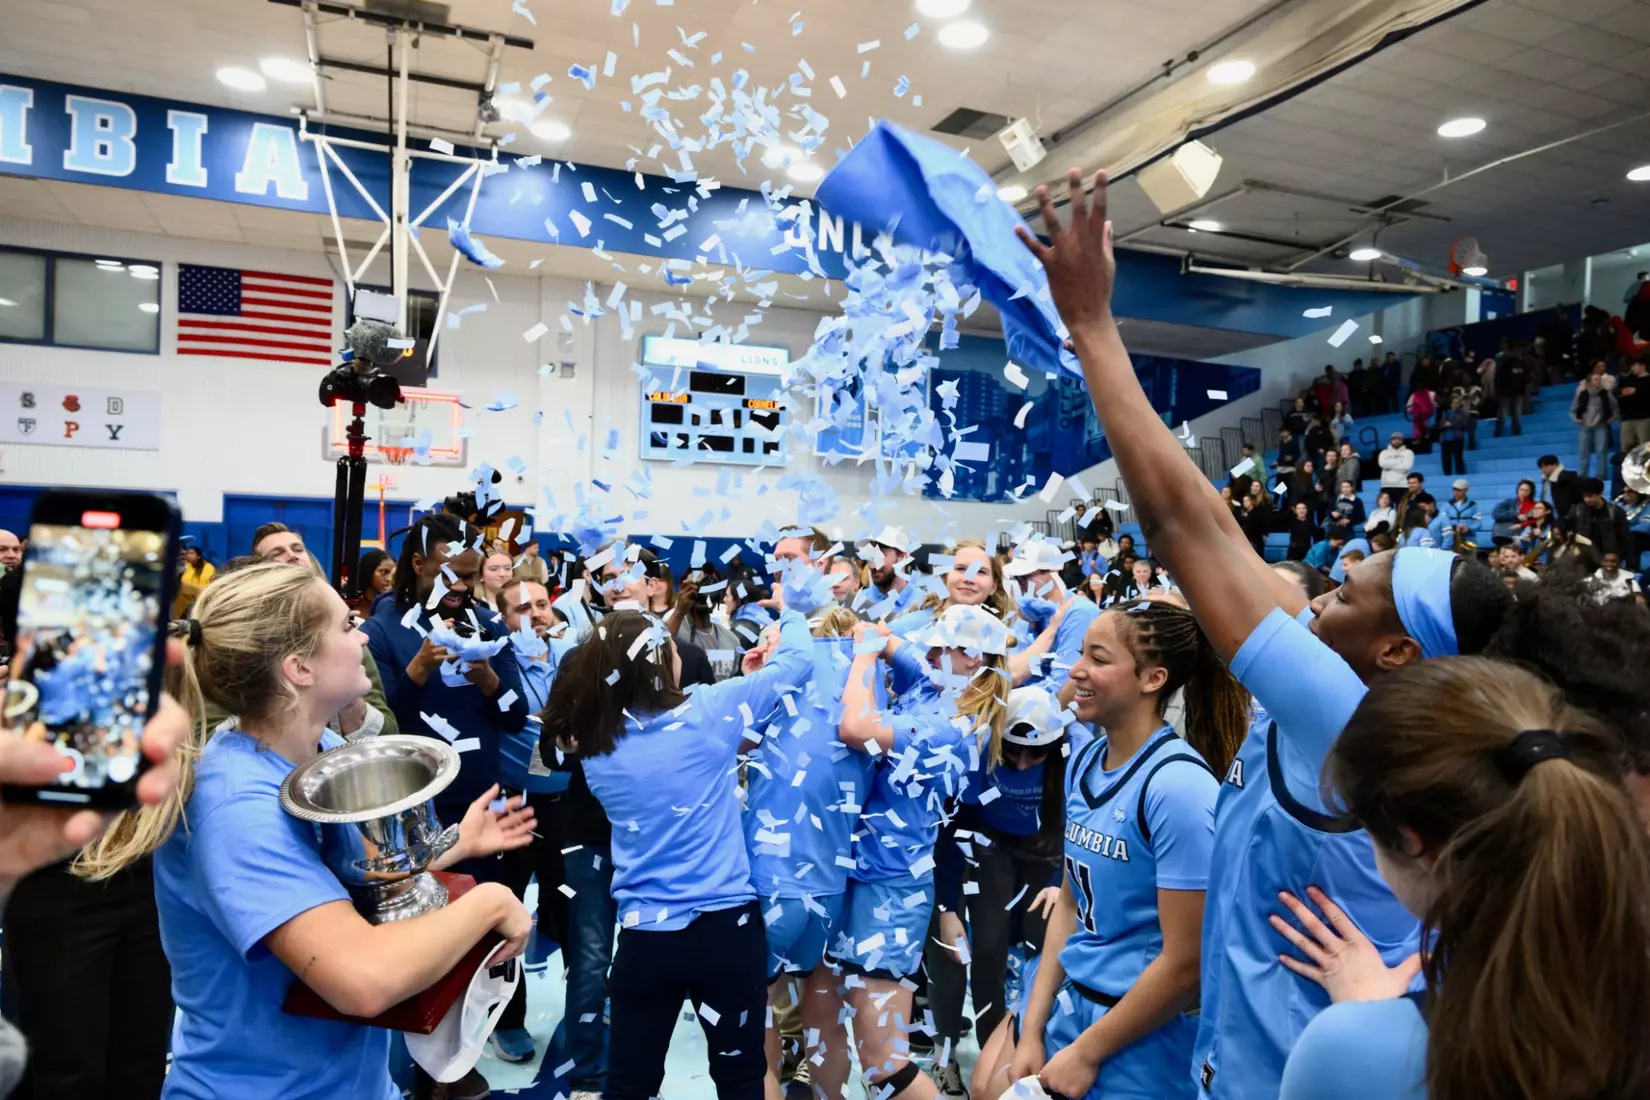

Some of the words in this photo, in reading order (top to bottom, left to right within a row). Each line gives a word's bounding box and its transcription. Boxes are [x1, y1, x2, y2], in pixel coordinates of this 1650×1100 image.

[741, 355, 778, 366] LIONS
[107, 397, 124, 415] D
[64, 421, 79, 438] P
[105, 424, 124, 440] Y
